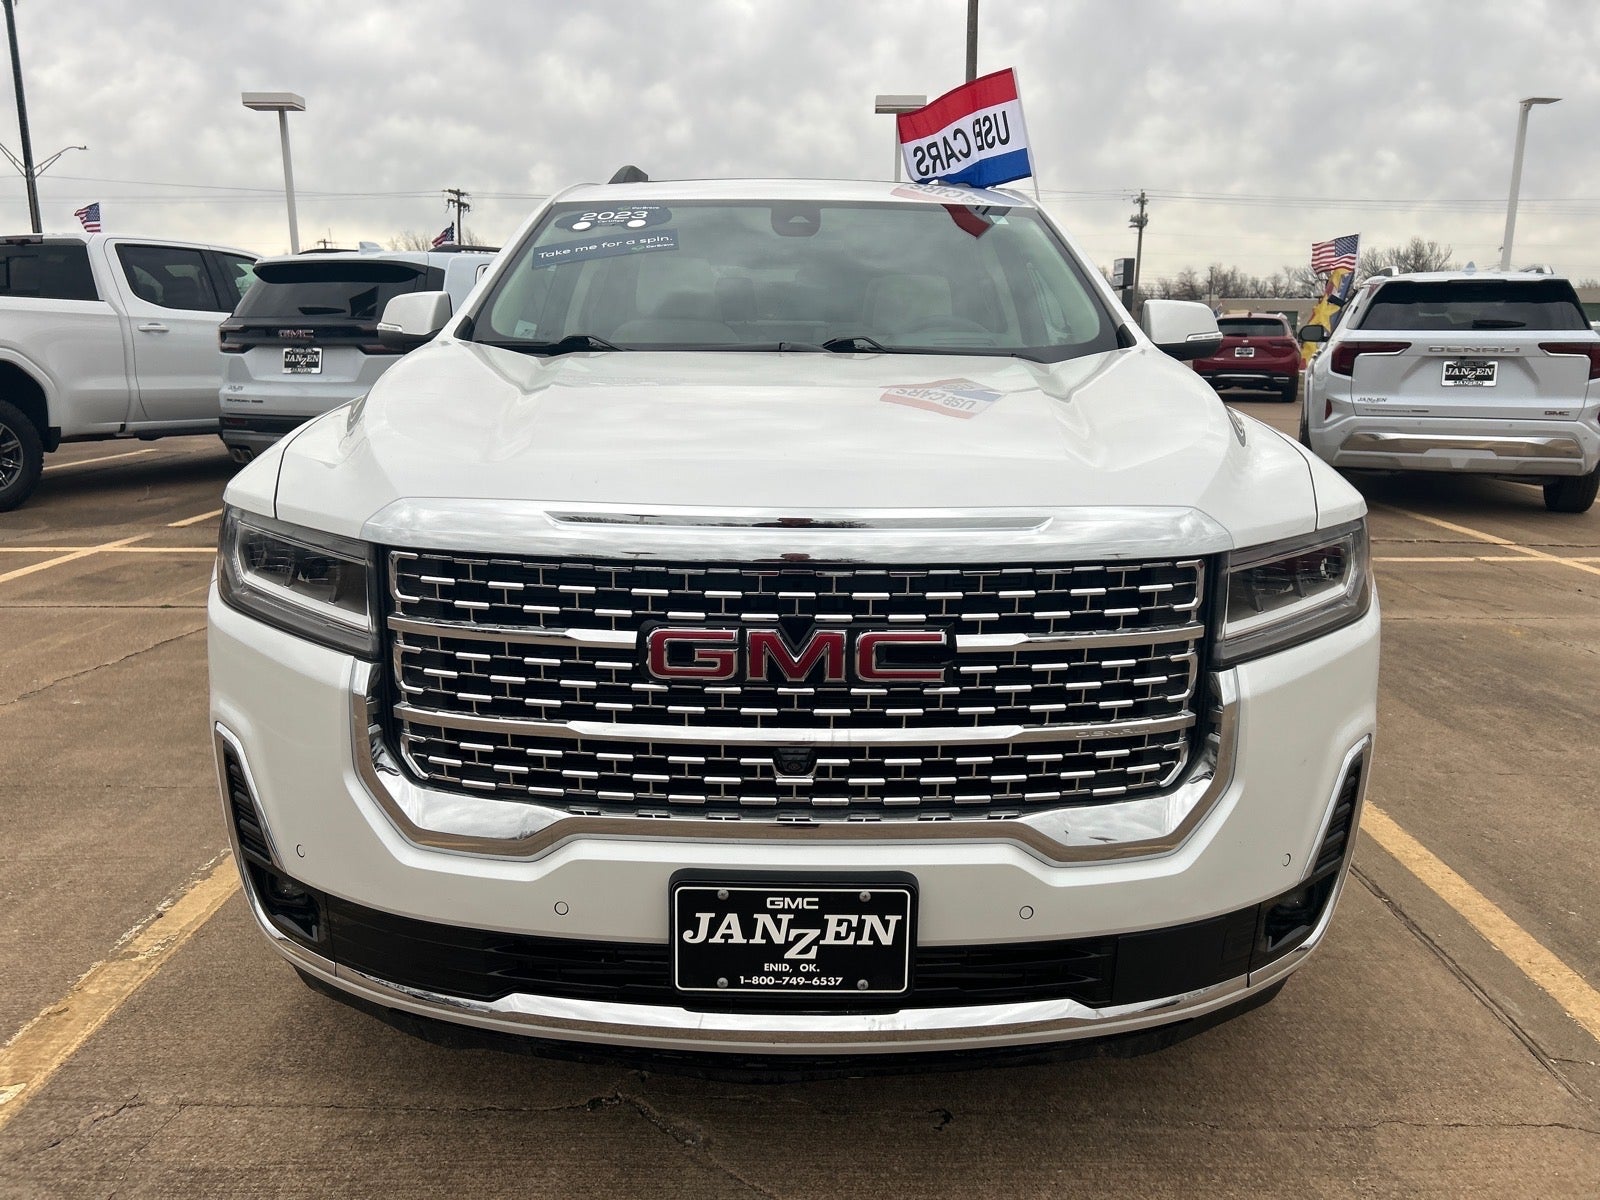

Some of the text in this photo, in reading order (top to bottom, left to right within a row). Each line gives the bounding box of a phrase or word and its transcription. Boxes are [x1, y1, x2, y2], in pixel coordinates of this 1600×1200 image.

[579, 211, 649, 221] 2023
[538, 248, 572, 259] Take
[575, 244, 598, 253] me
[601, 239, 623, 249] for
[639, 235, 673, 244] spin.
[1428, 345, 1520, 354] DENALI
[285, 354, 320, 365] JANZEN
[1445, 367, 1494, 379] JANZEN
[646, 626, 948, 683] GMC
[766, 897, 819, 910] GMC
[682, 912, 902, 960] JANZEN
[764, 963, 821, 974] ENID, OK.
[739, 976, 843, 986] 1-800-749-6537
